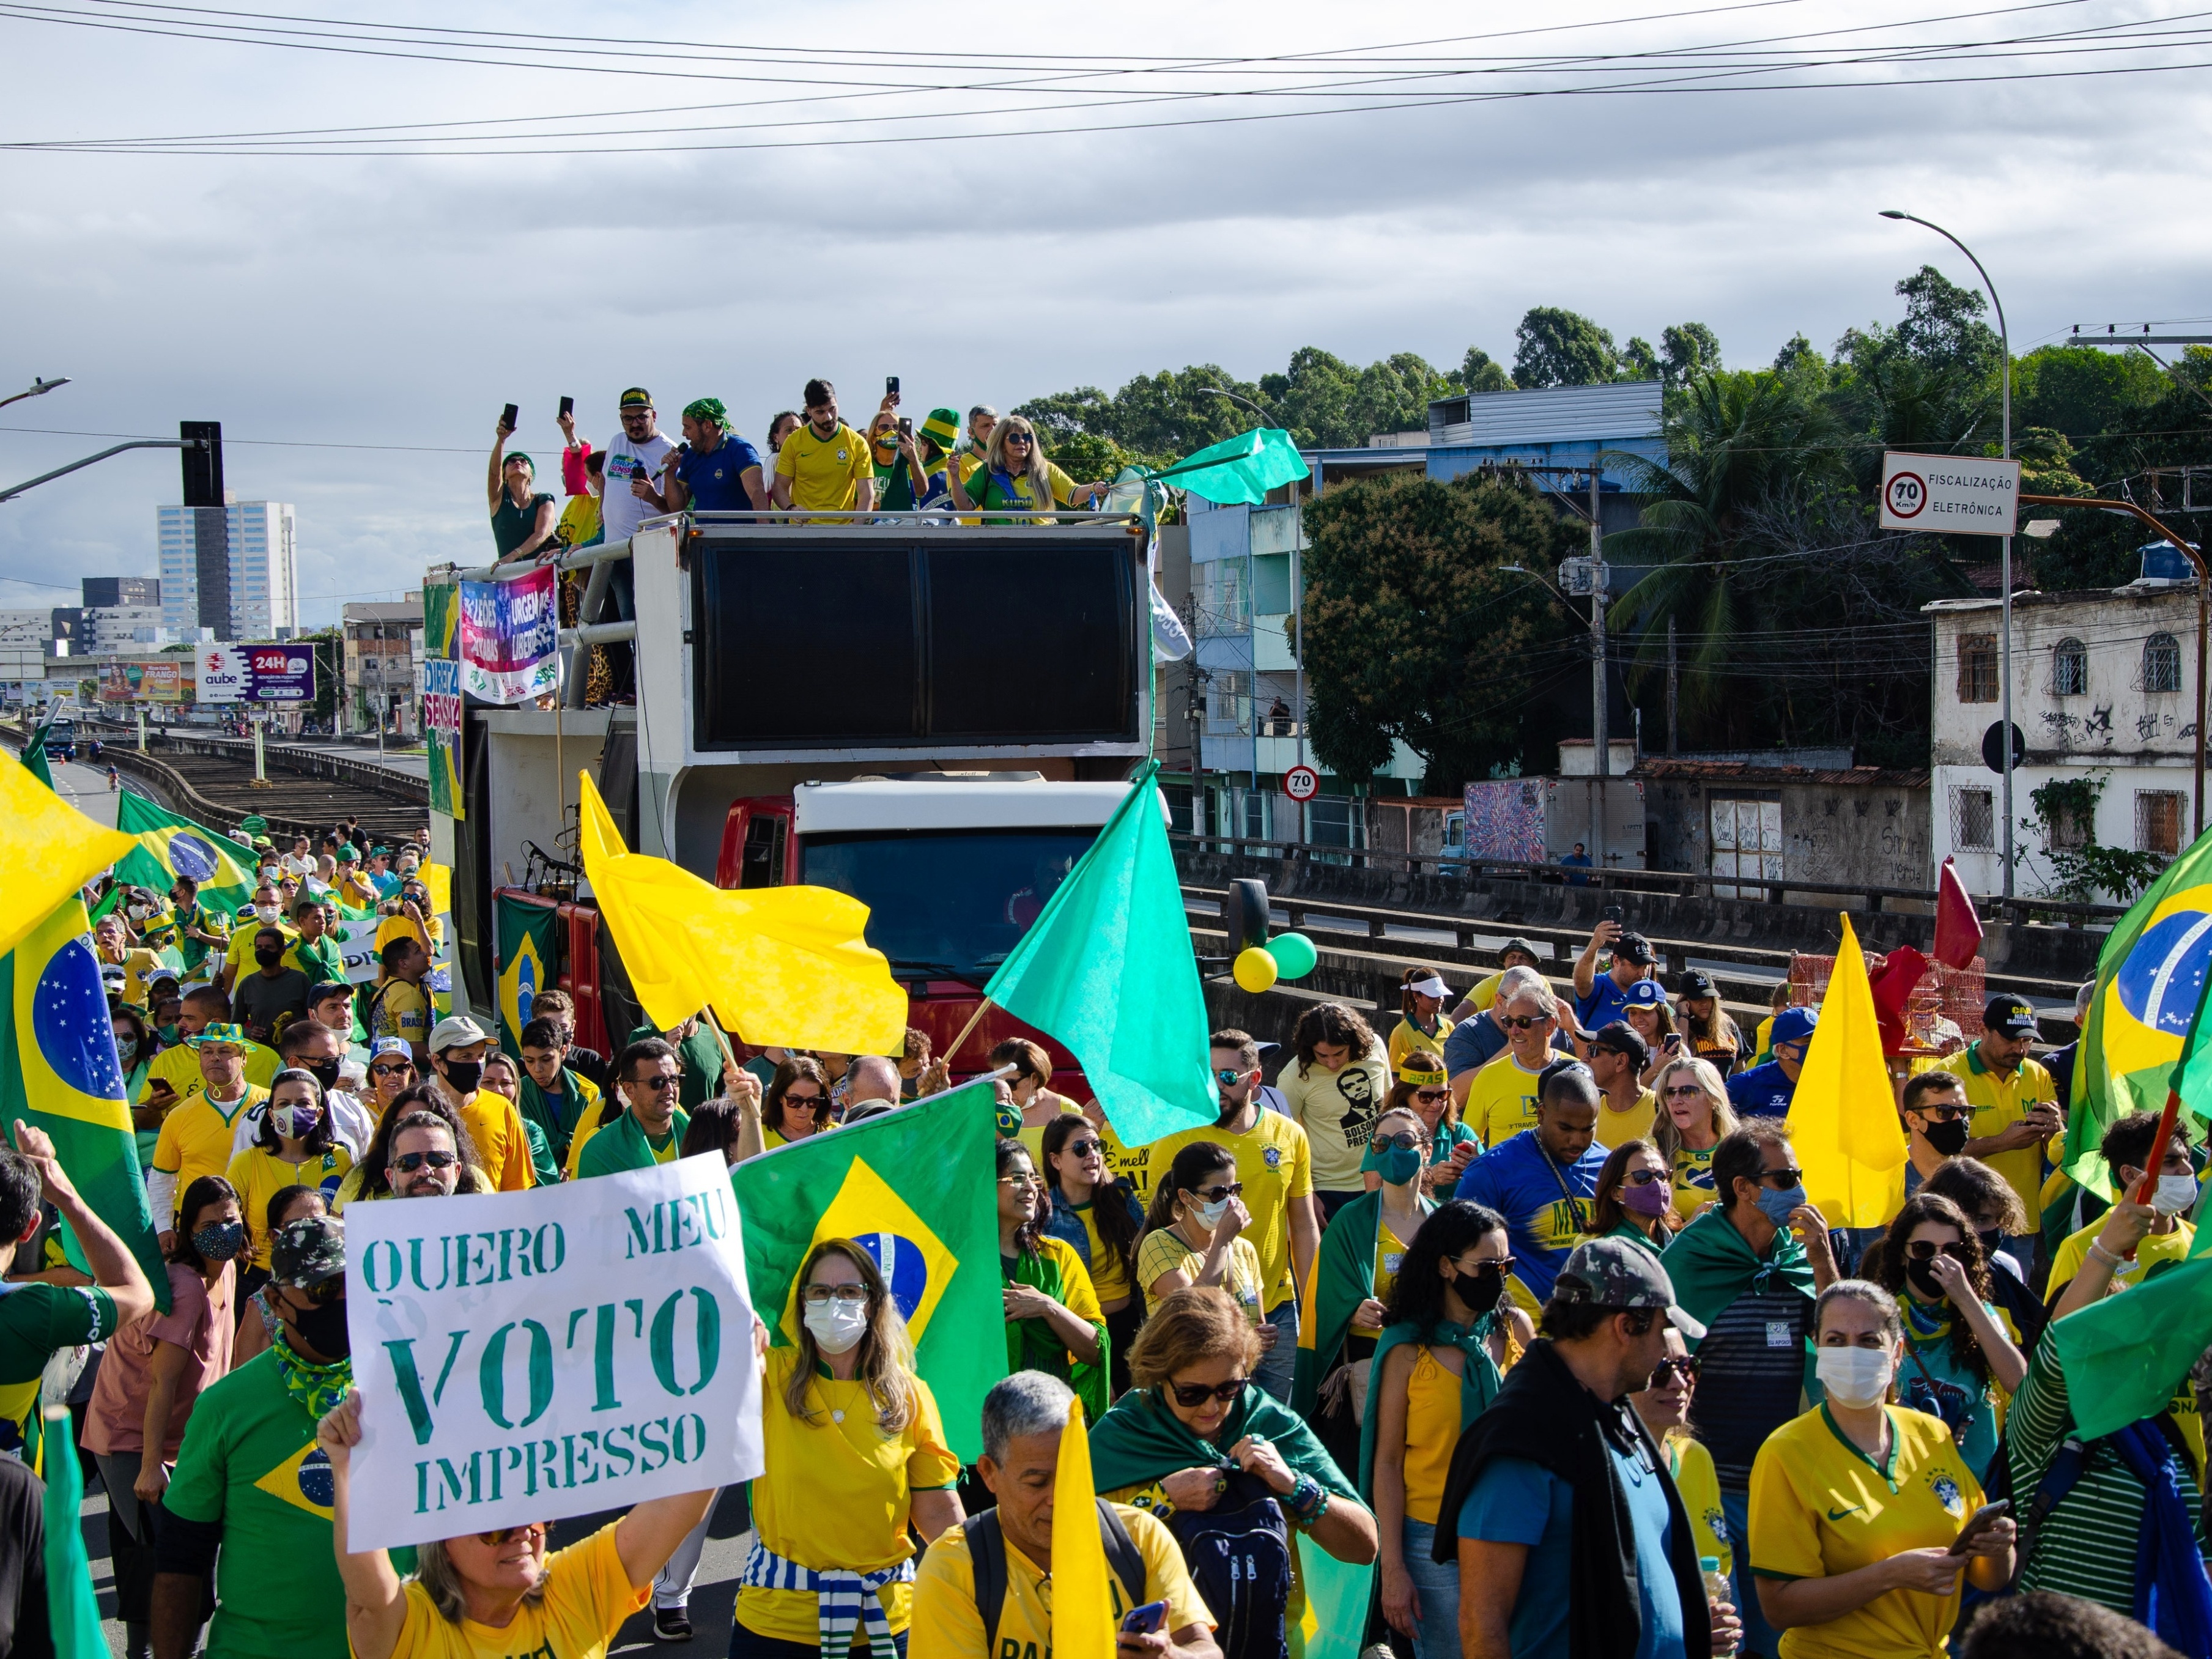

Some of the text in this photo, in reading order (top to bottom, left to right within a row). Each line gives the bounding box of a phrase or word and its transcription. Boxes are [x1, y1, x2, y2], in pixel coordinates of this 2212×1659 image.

[1896, 482, 1918, 500] 70
[1929, 474, 2011, 491] FISCALIZAÇÃO
[1933, 501, 2002, 516] ELETRÔNICA
[511, 591, 538, 626] URGEM
[256, 657, 284, 668] 24H
[205, 673, 237, 684] aube
[426, 660, 459, 696] DIRETA
[1292, 775, 1311, 786] 70
[1344, 1117, 1377, 1139] BOLSON
[363, 1188, 726, 1304] QUERO MEU
[1549, 1238, 1574, 1246] MOVIMENT
[882, 1238, 892, 1271] ORDEM
[382, 1287, 720, 1445] VOTO
[414, 1413, 706, 1513] IMPRESSO
